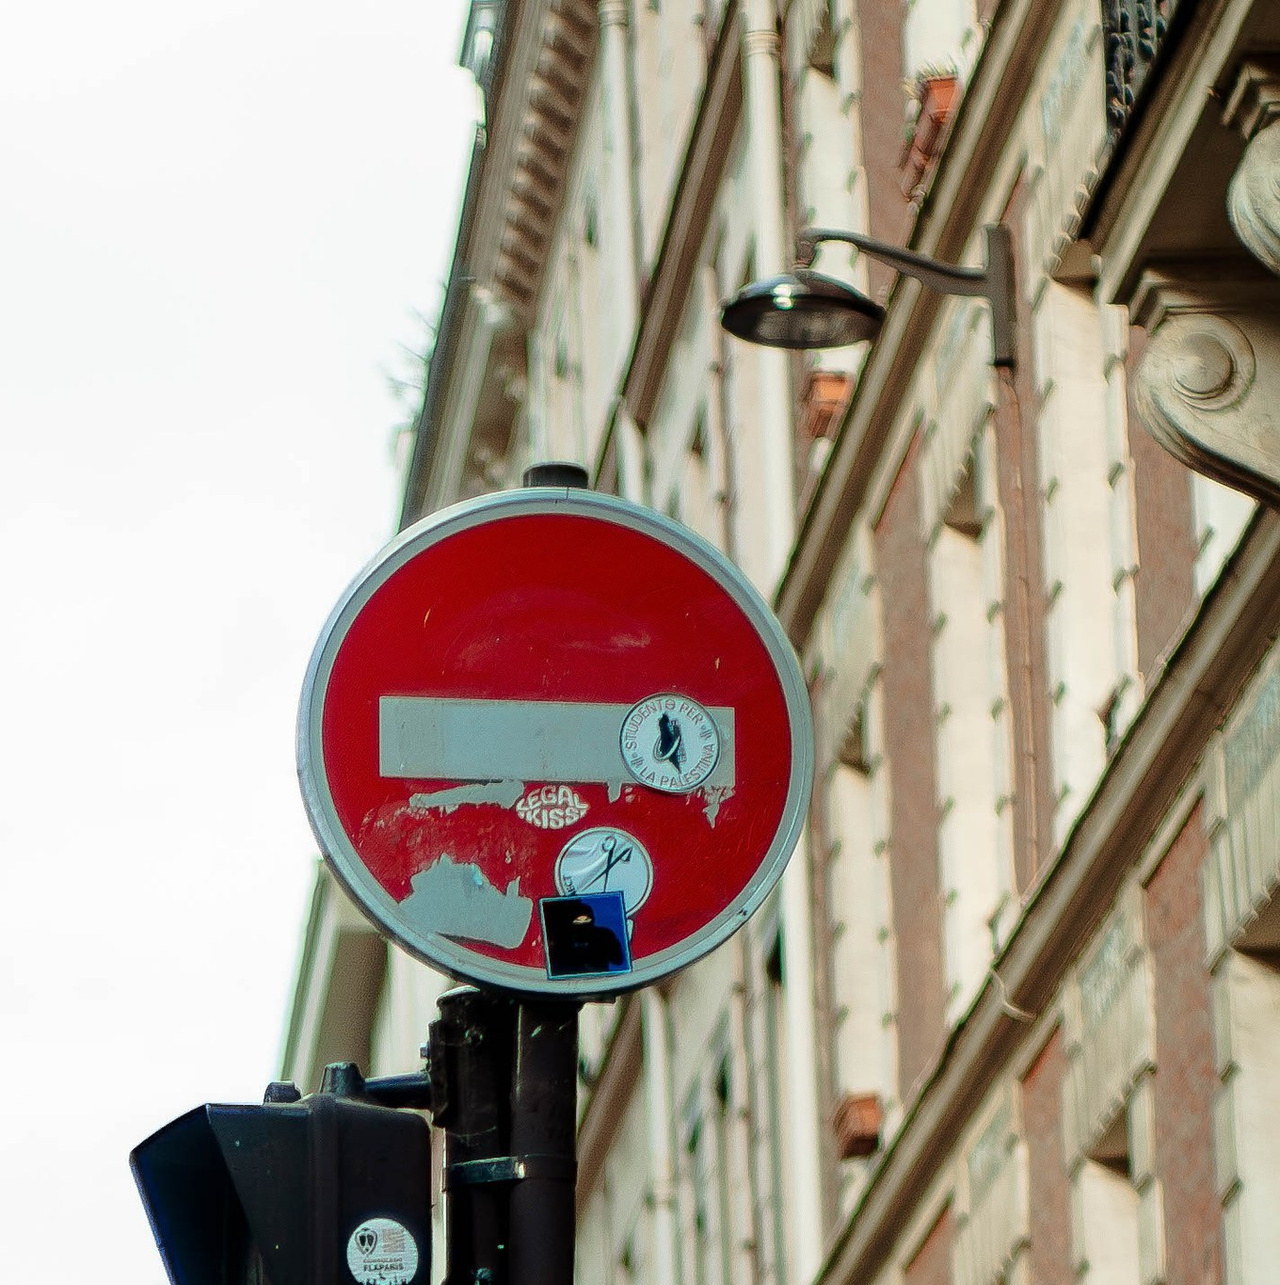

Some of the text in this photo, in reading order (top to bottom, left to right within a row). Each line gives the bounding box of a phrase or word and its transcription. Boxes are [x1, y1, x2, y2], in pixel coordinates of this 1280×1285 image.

[680, 701, 704, 725] PER
[639, 743, 716, 788] LA PALESTINA
[516, 784, 589, 811] LEGAL
